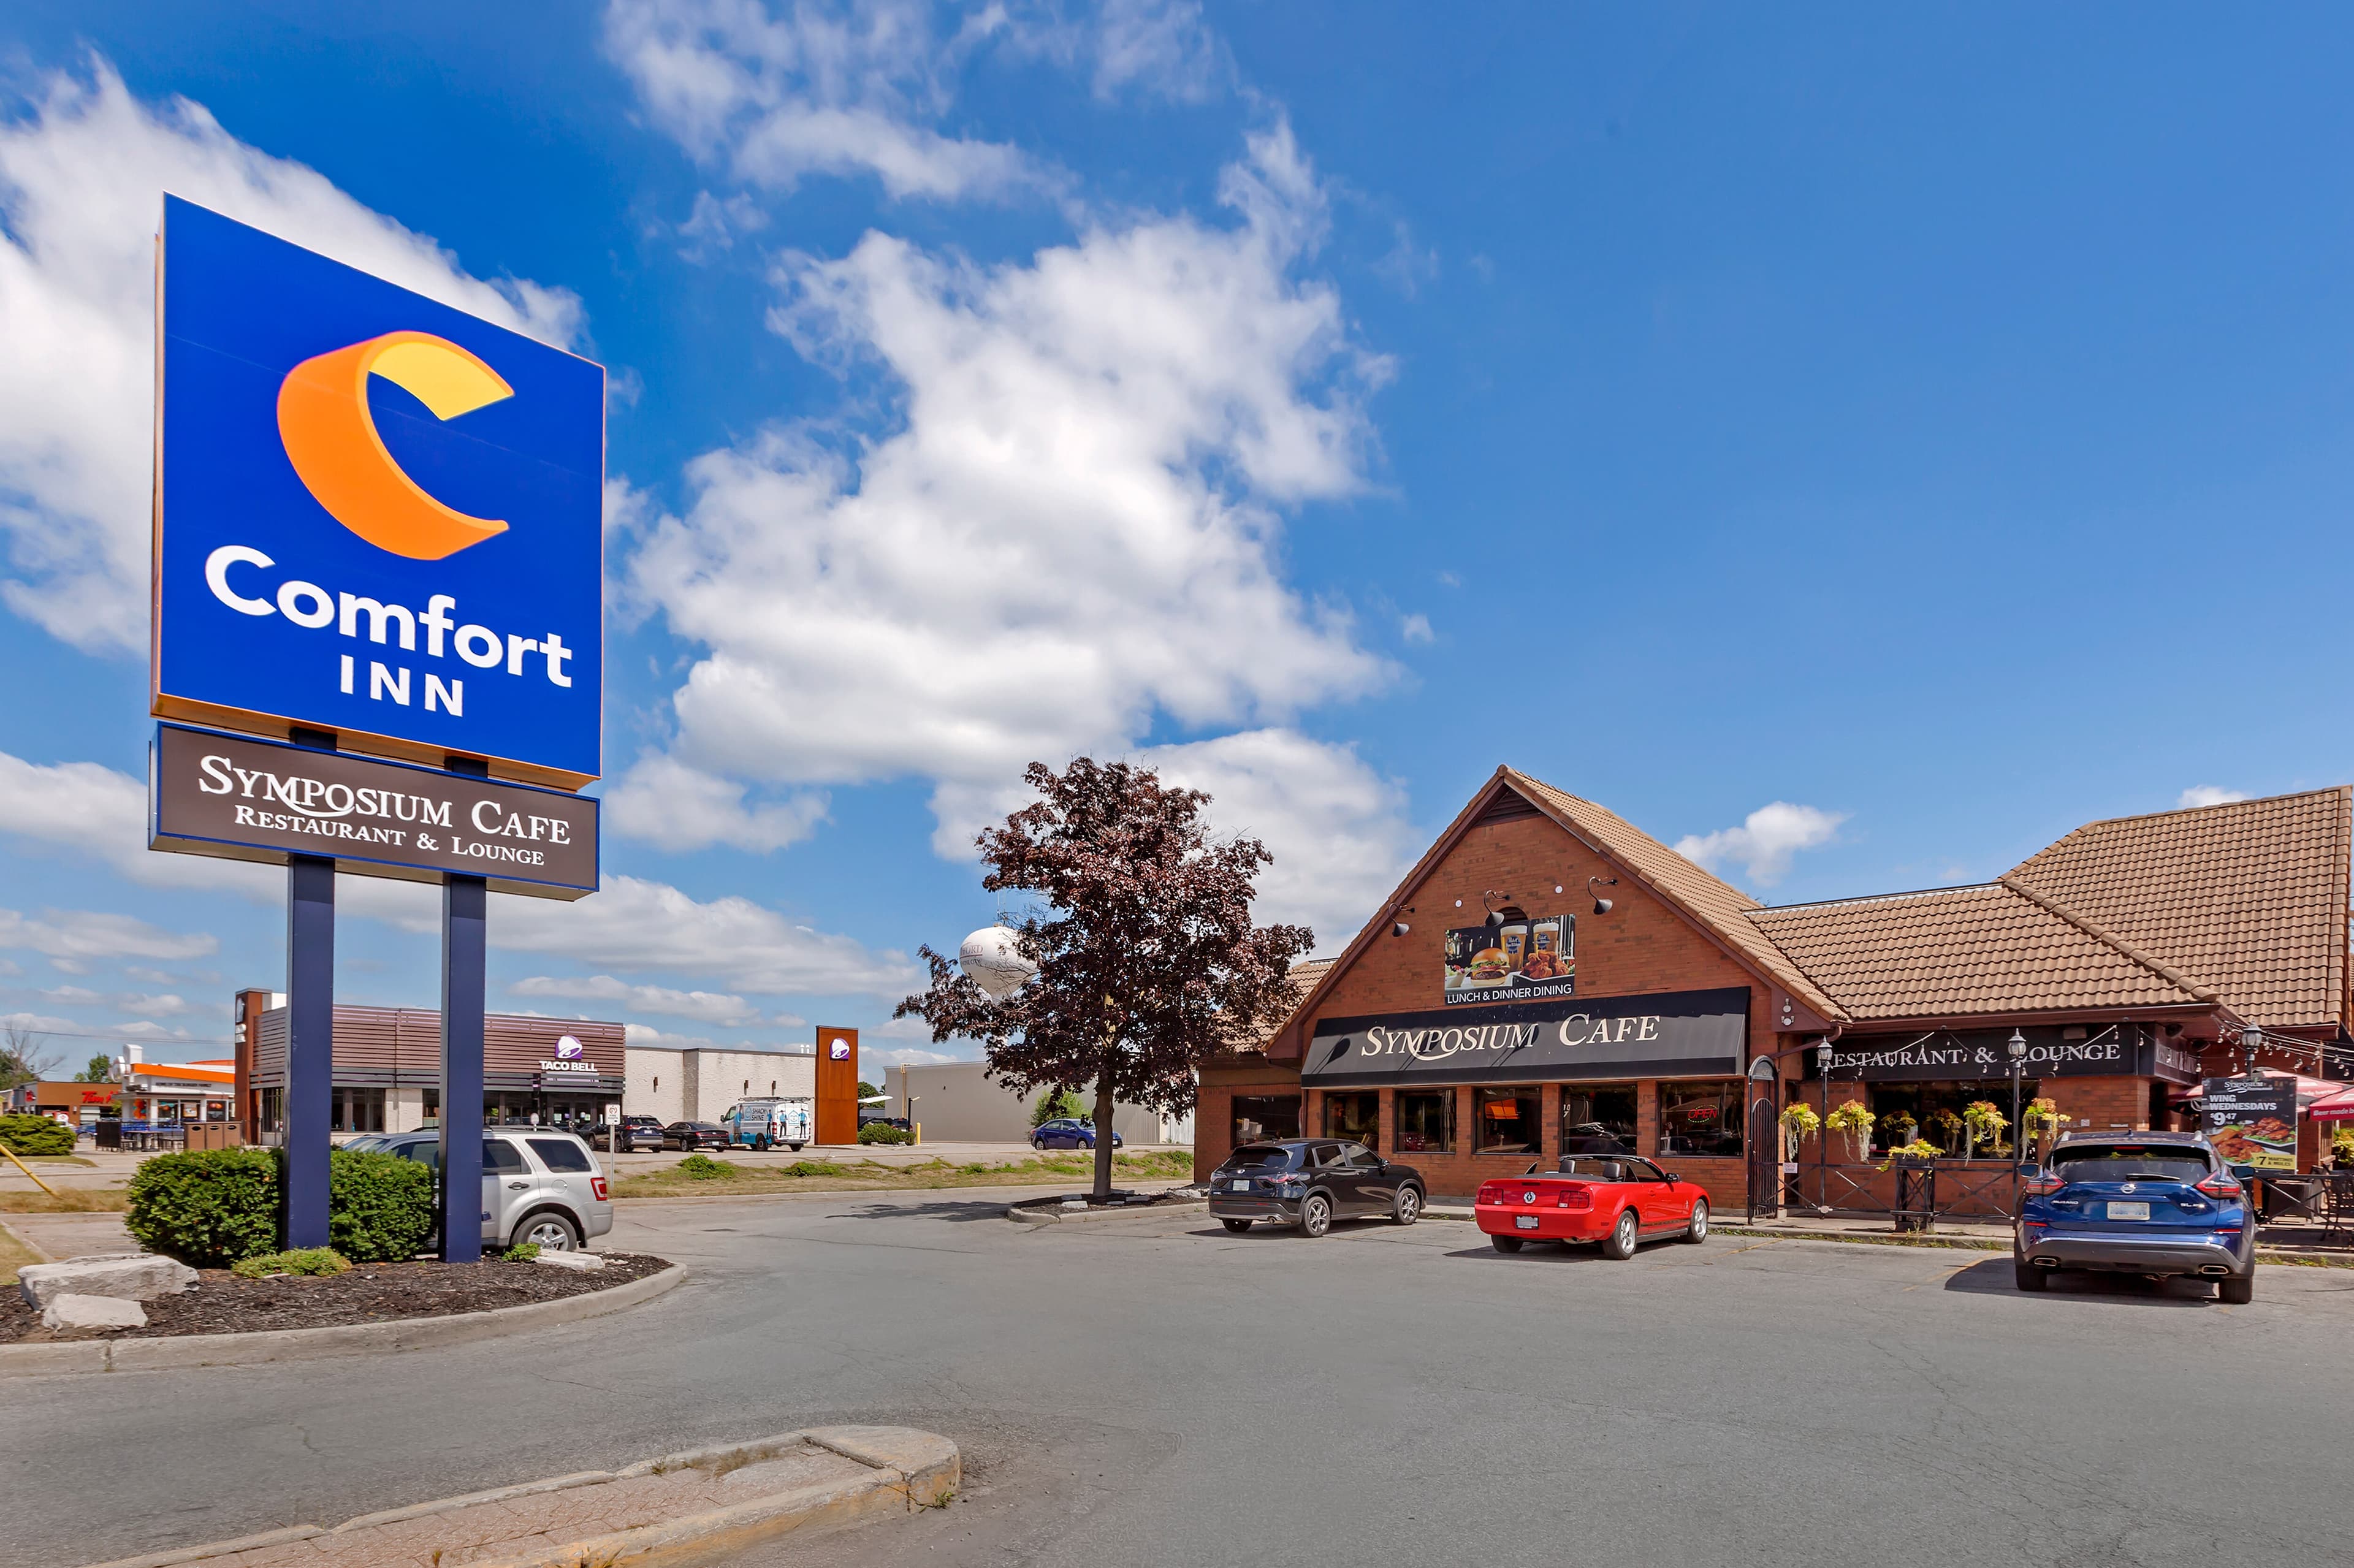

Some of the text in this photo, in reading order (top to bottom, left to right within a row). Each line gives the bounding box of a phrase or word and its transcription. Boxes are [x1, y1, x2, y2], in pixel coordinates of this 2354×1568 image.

[205, 545, 572, 688] Comfort
[340, 654, 463, 717] INN
[198, 755, 571, 845] SYMPOSIUM CAFE
[234, 805, 545, 866] RESTAURANT & LOUNGE
[1447, 984, 1572, 1004] LUNCH & DINNER DINING
[1361, 1013, 1661, 1061] SYMPOSIUM CAFE
[1816, 1049, 1963, 1068] ESTAURANT
[1974, 1046, 1997, 1064] &
[539, 1060, 598, 1071] TACO BELL
[1688, 1108, 1718, 1119] OPEN
